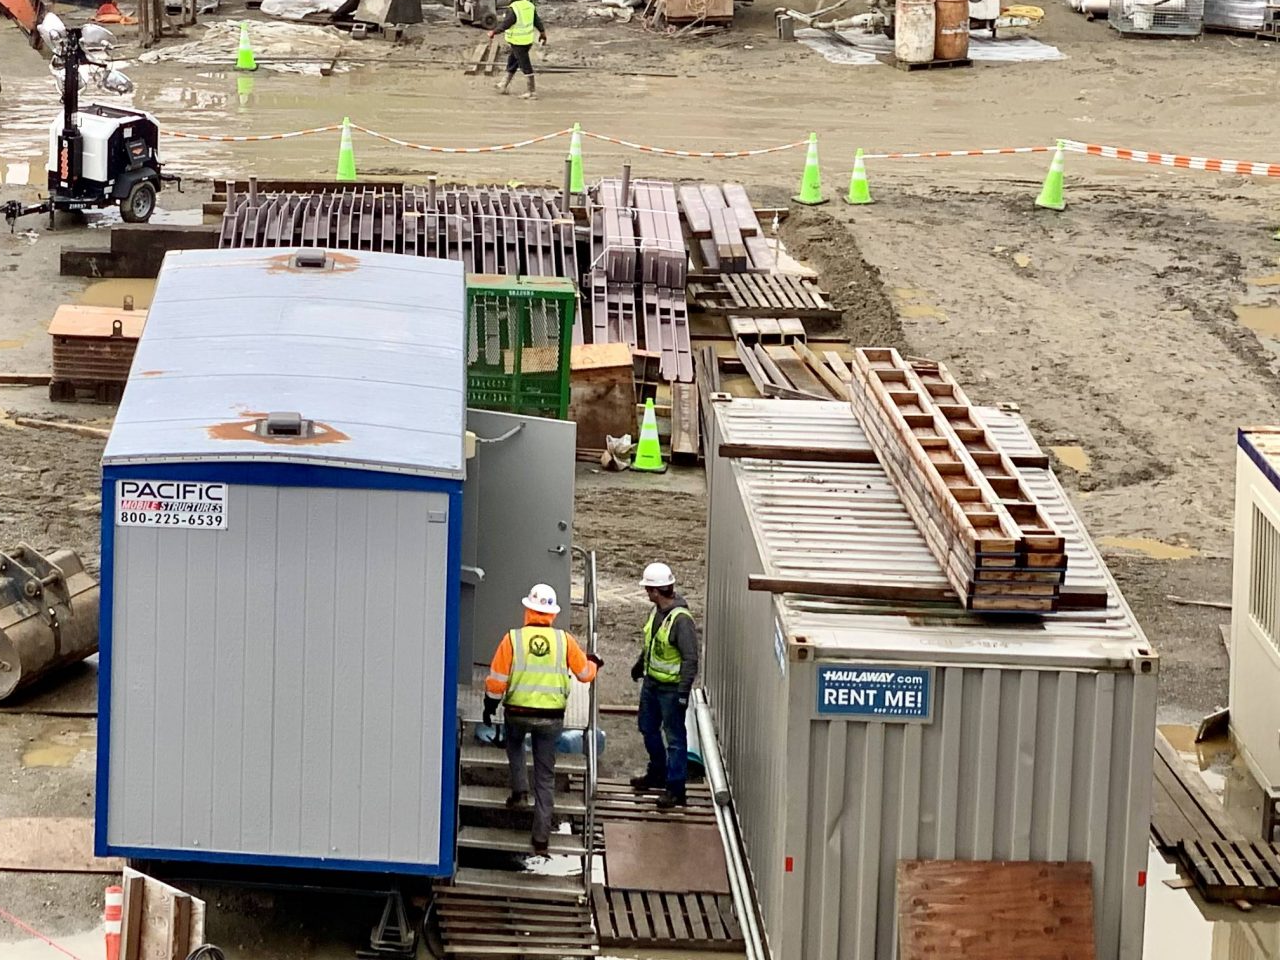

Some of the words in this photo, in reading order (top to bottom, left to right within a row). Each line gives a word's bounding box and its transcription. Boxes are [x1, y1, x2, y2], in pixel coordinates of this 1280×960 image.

[122, 500, 159, 511] MOBILE
[159, 502, 223, 513] STRUCTURES
[121, 512, 223, 526] 800-225-6539
[824, 688, 877, 706] RENT
[884, 690, 922, 708] ME!
